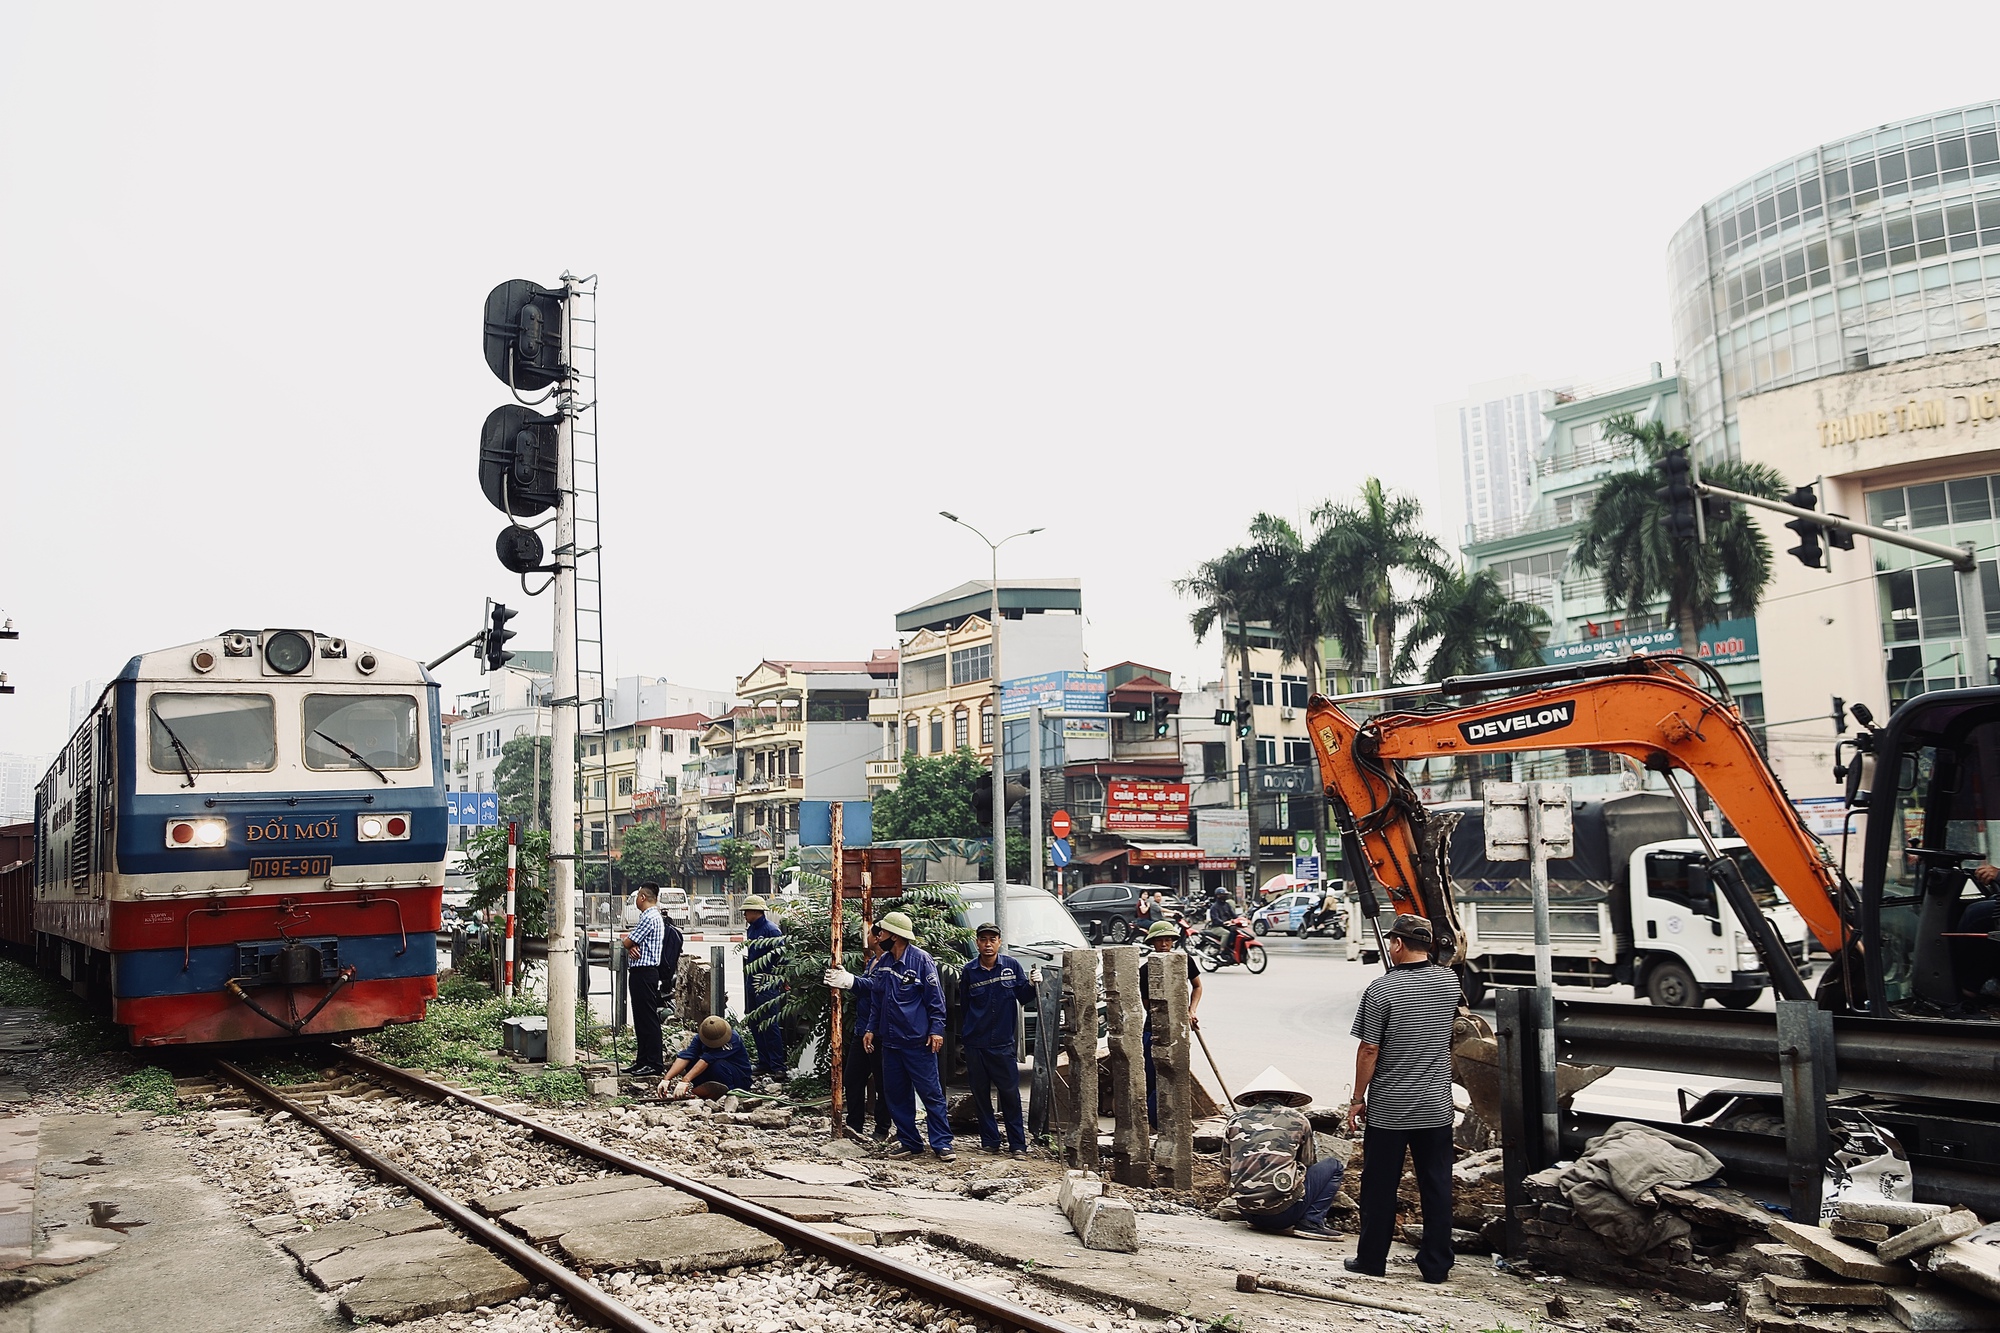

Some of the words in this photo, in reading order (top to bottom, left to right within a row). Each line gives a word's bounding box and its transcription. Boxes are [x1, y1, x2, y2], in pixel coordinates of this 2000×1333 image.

[1816, 409, 1889, 448] TRUNG
[1893, 399, 1945, 433] TÂM
[1554, 647, 1567, 658] BỘ
[1568, 644, 1592, 656] GIÁO
[1593, 641, 1614, 652] DỤC
[1630, 635, 1653, 647] ĐÀO
[1653, 632, 1675, 644] TẠO
[1713, 637, 1745, 656] NỘI
[1468, 706, 1569, 740] DEVELON
[246, 815, 289, 841] ĐỔI
[294, 816, 339, 840] MỚI
[253, 859, 328, 878] D19E-901
